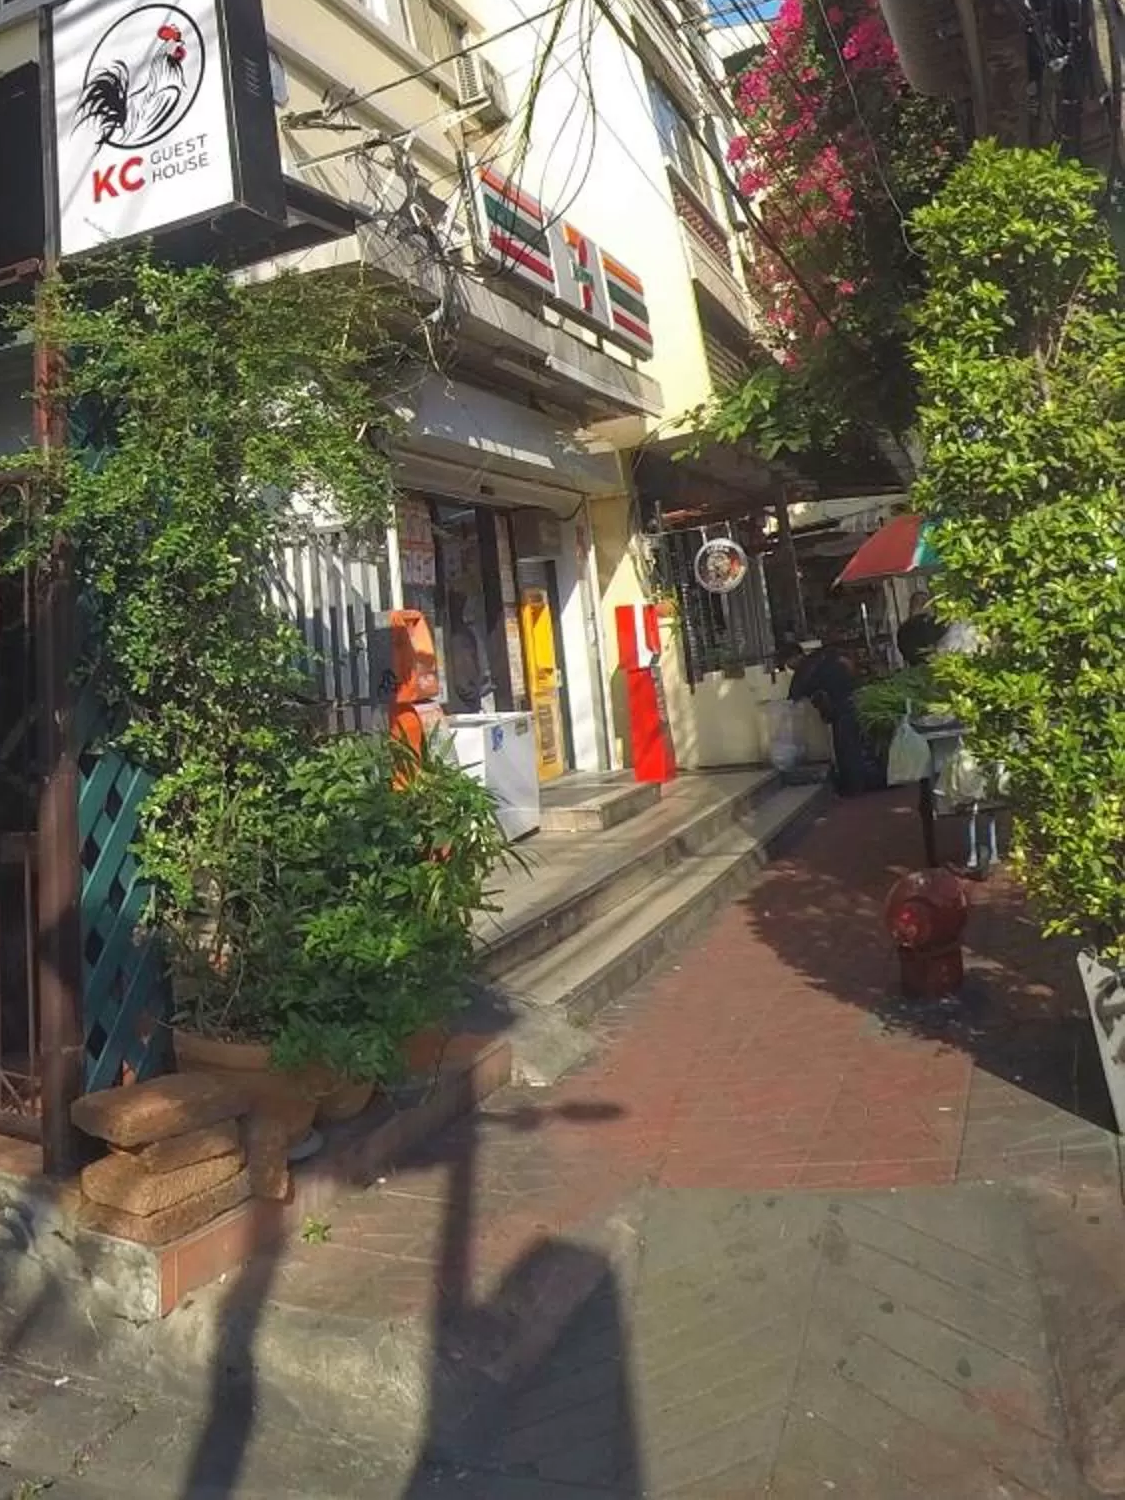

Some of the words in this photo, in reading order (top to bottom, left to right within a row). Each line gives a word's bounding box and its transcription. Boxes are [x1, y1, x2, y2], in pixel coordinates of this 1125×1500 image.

[150, 133, 207, 165] GUEST
[93, 156, 145, 203] KC
[152, 152, 209, 183] HOUSE
